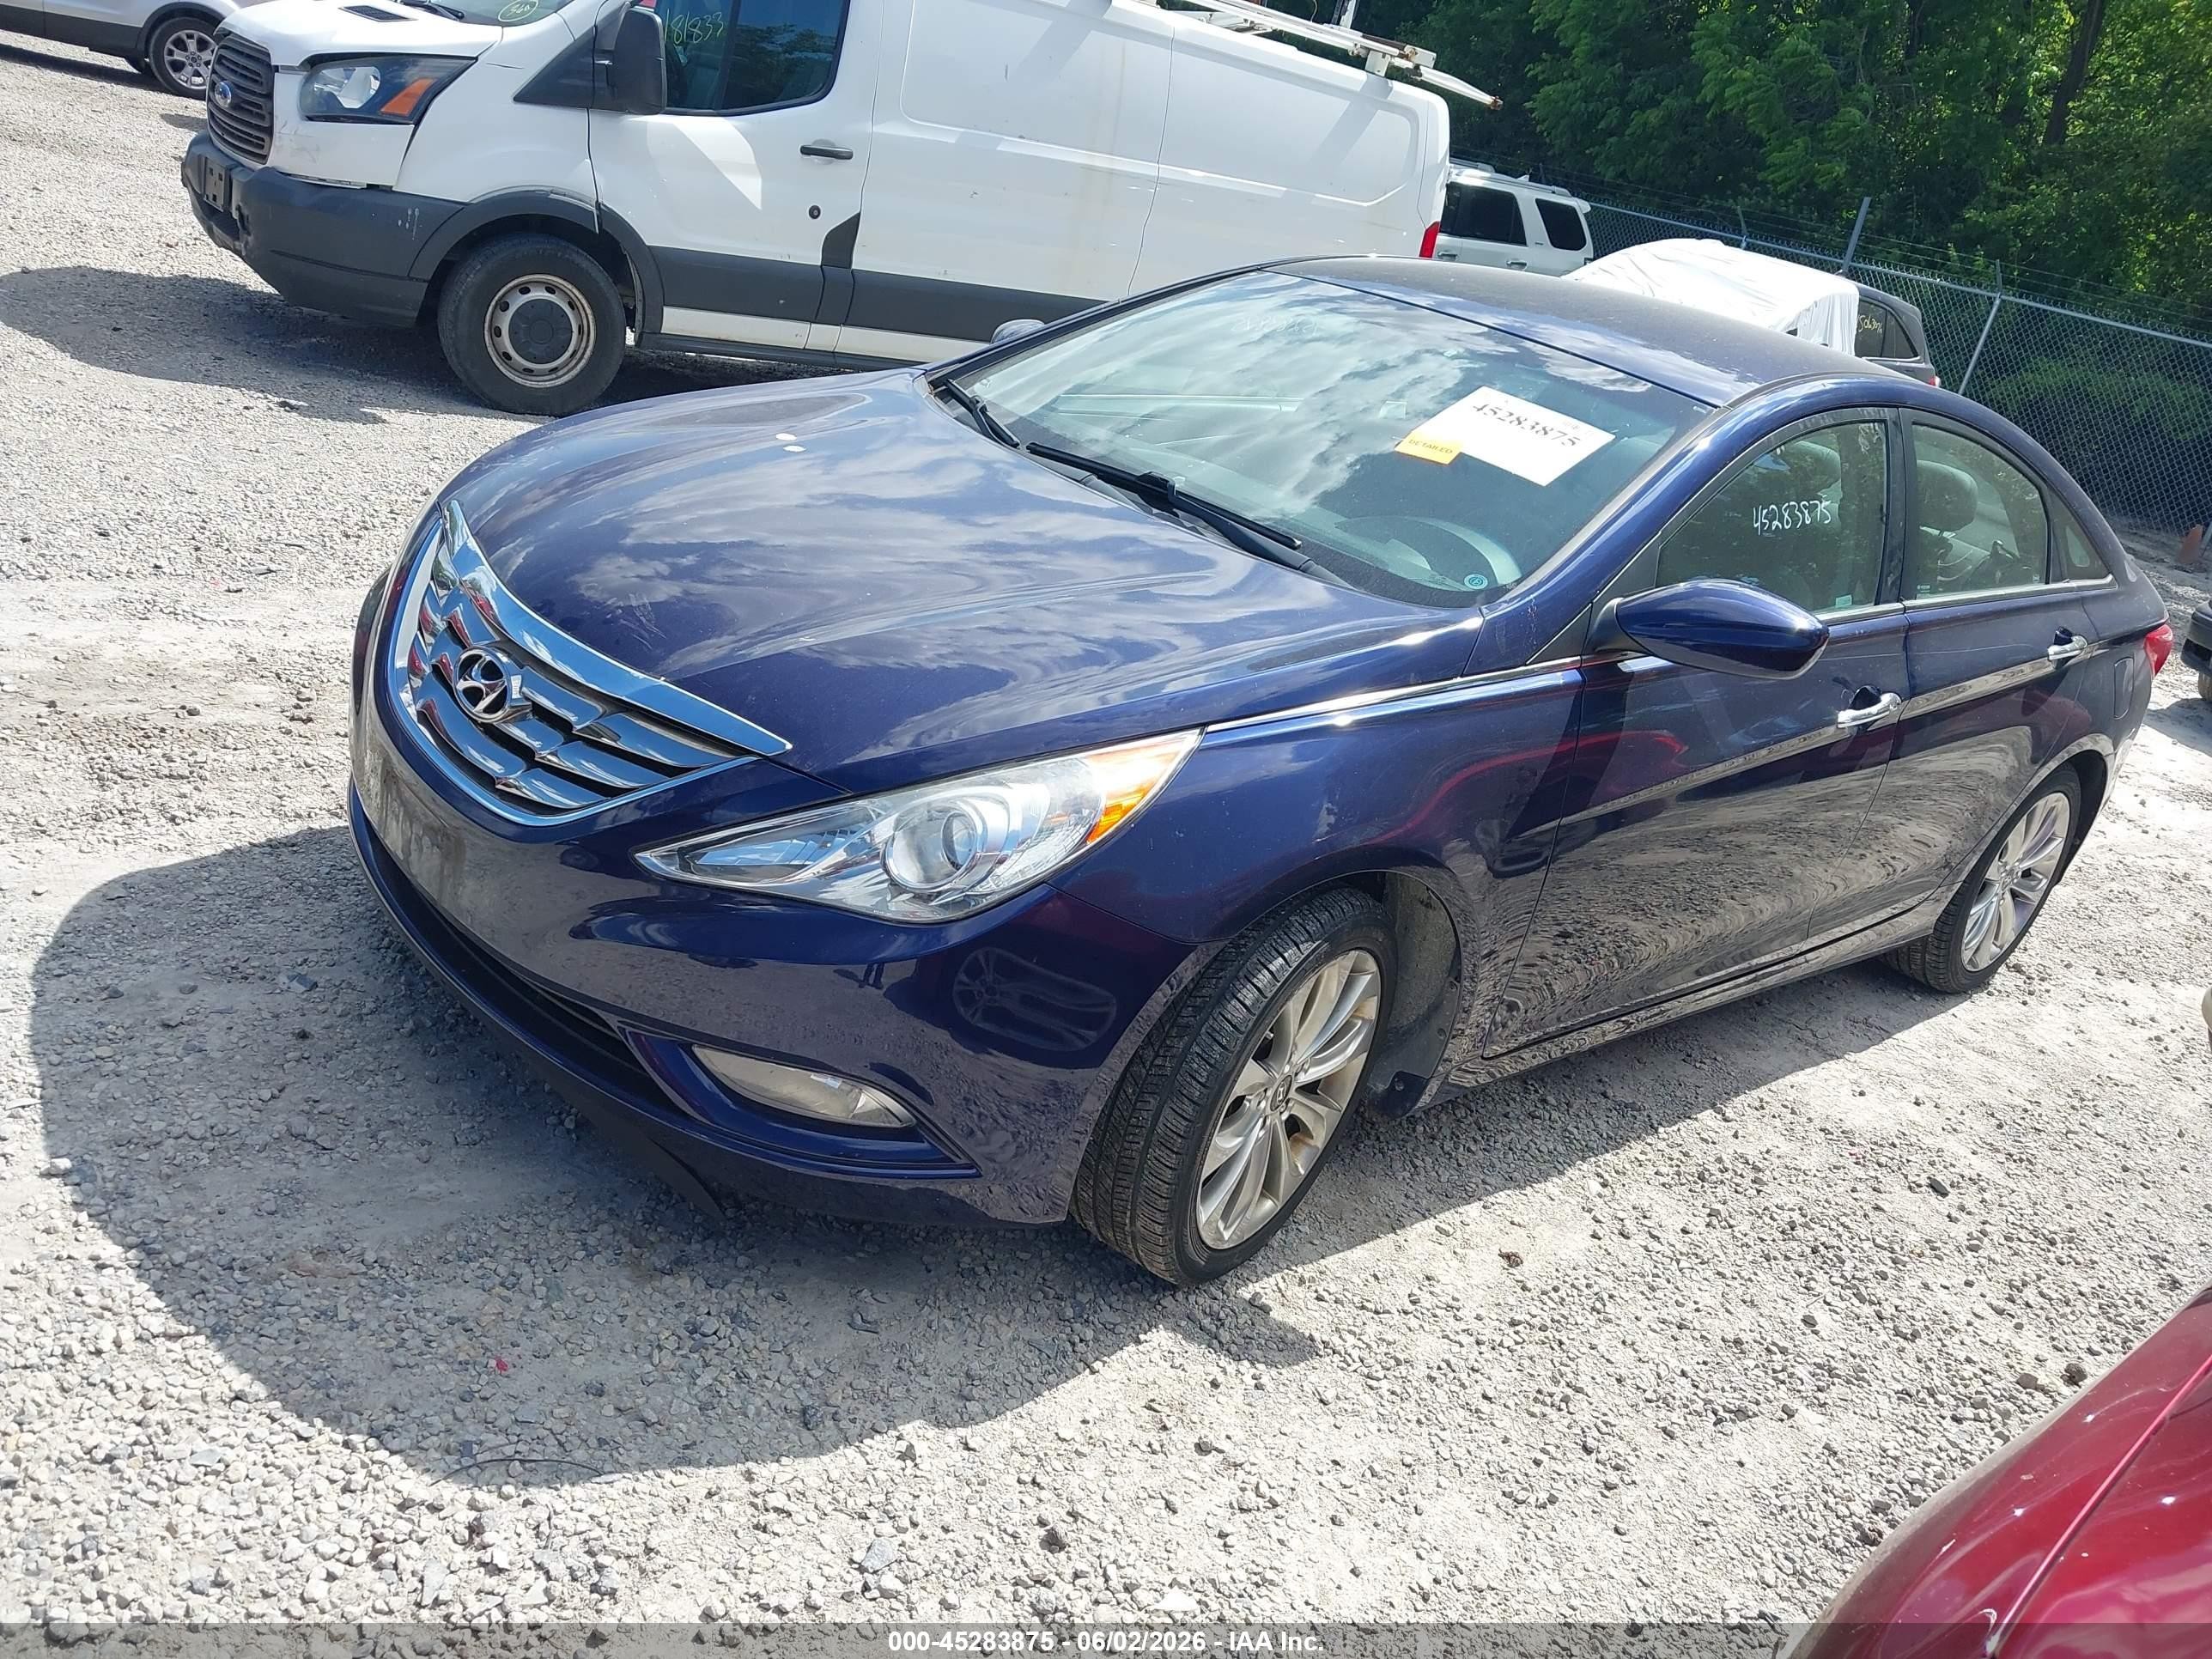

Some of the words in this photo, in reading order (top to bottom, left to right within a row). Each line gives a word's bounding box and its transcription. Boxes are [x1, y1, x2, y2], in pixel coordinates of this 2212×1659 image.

[1472, 403, 1582, 447] 45283875
[1407, 438, 1454, 455] DETAILED
[1753, 495, 1832, 536] 45283875
